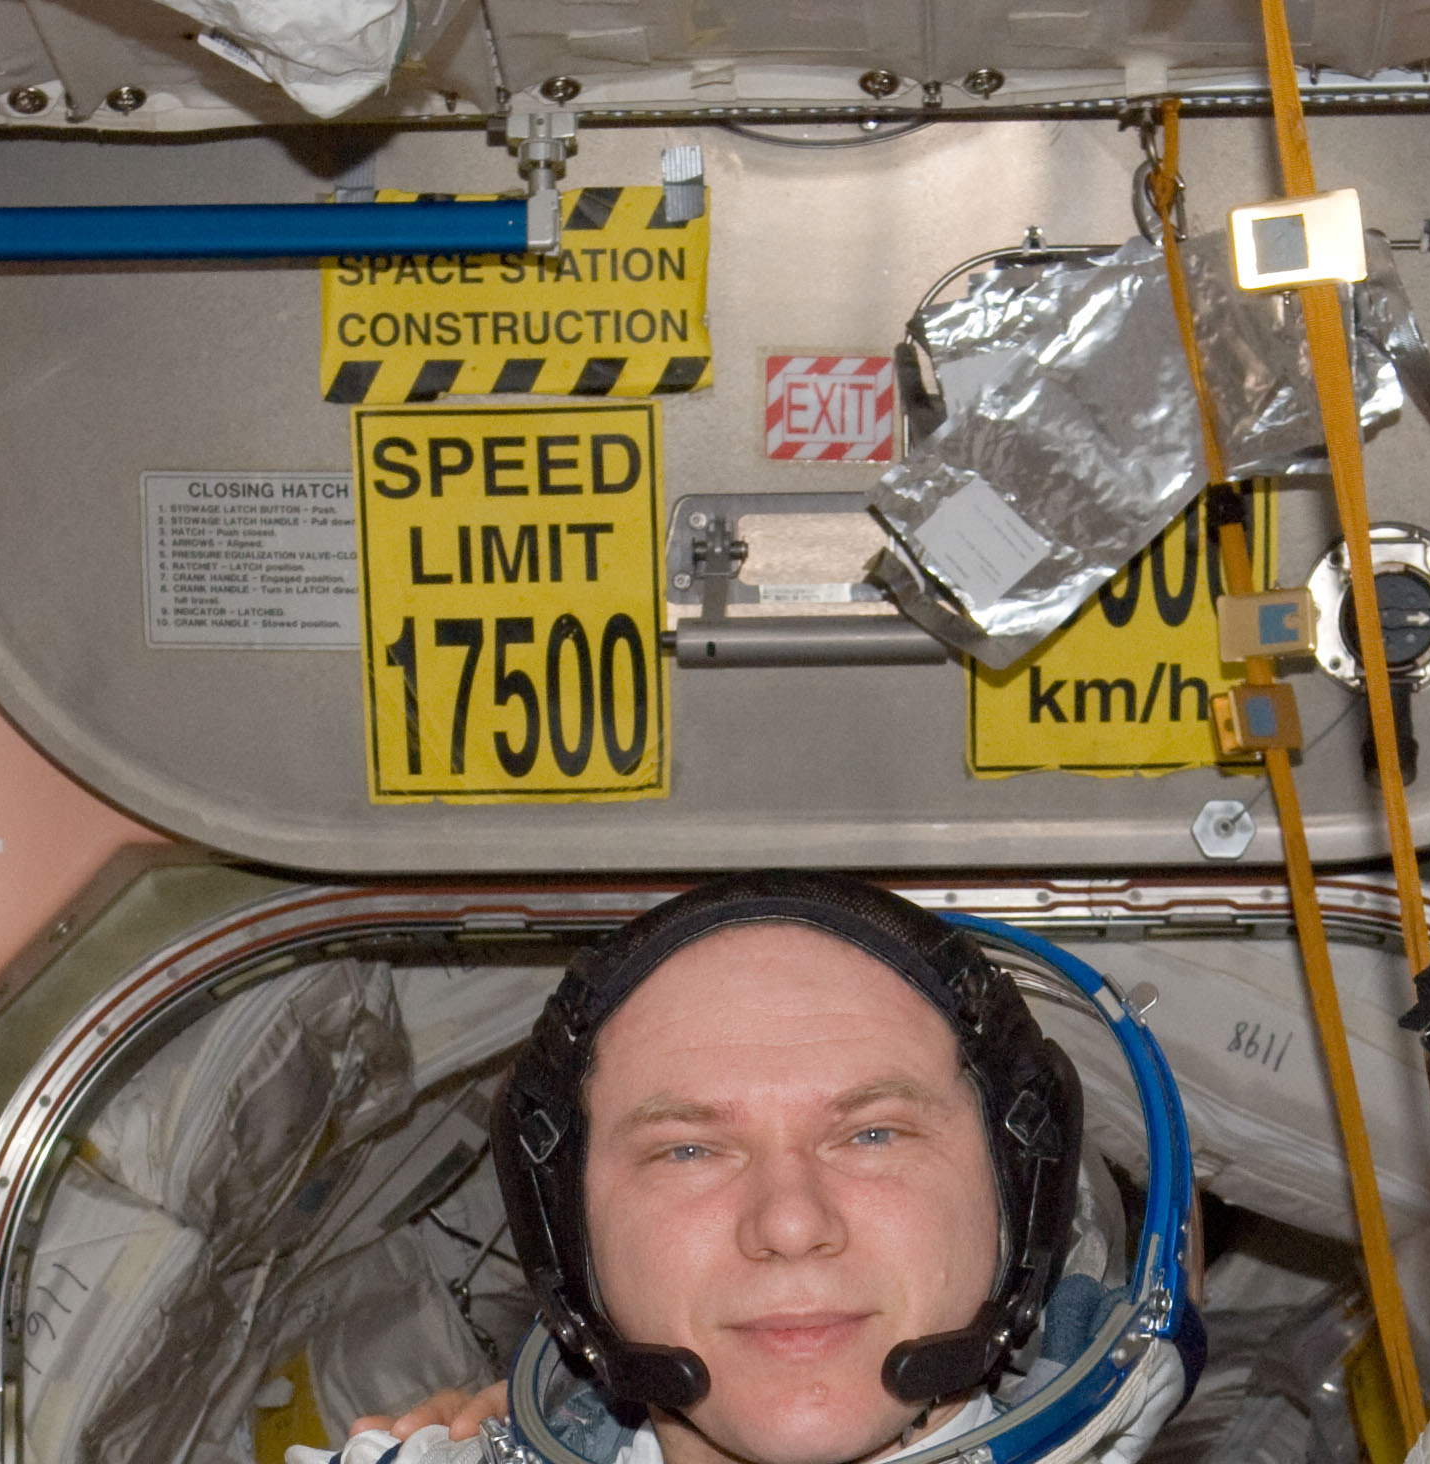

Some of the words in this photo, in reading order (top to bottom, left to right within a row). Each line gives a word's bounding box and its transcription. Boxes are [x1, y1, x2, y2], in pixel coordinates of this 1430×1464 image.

[337, 253, 485, 285] SPACE
[500, 247, 686, 284] STATION
[337, 309, 689, 347] CONSTRUCTION
[785, 380, 867, 436] EXIT
[188, 482, 274, 499] CLOSING
[282, 483, 349, 499] HATCH
[372, 433, 642, 499] SPEED
[411, 523, 613, 585] LIMIT
[385, 612, 648, 778] 17500
[1029, 662, 1209, 723] km/h
